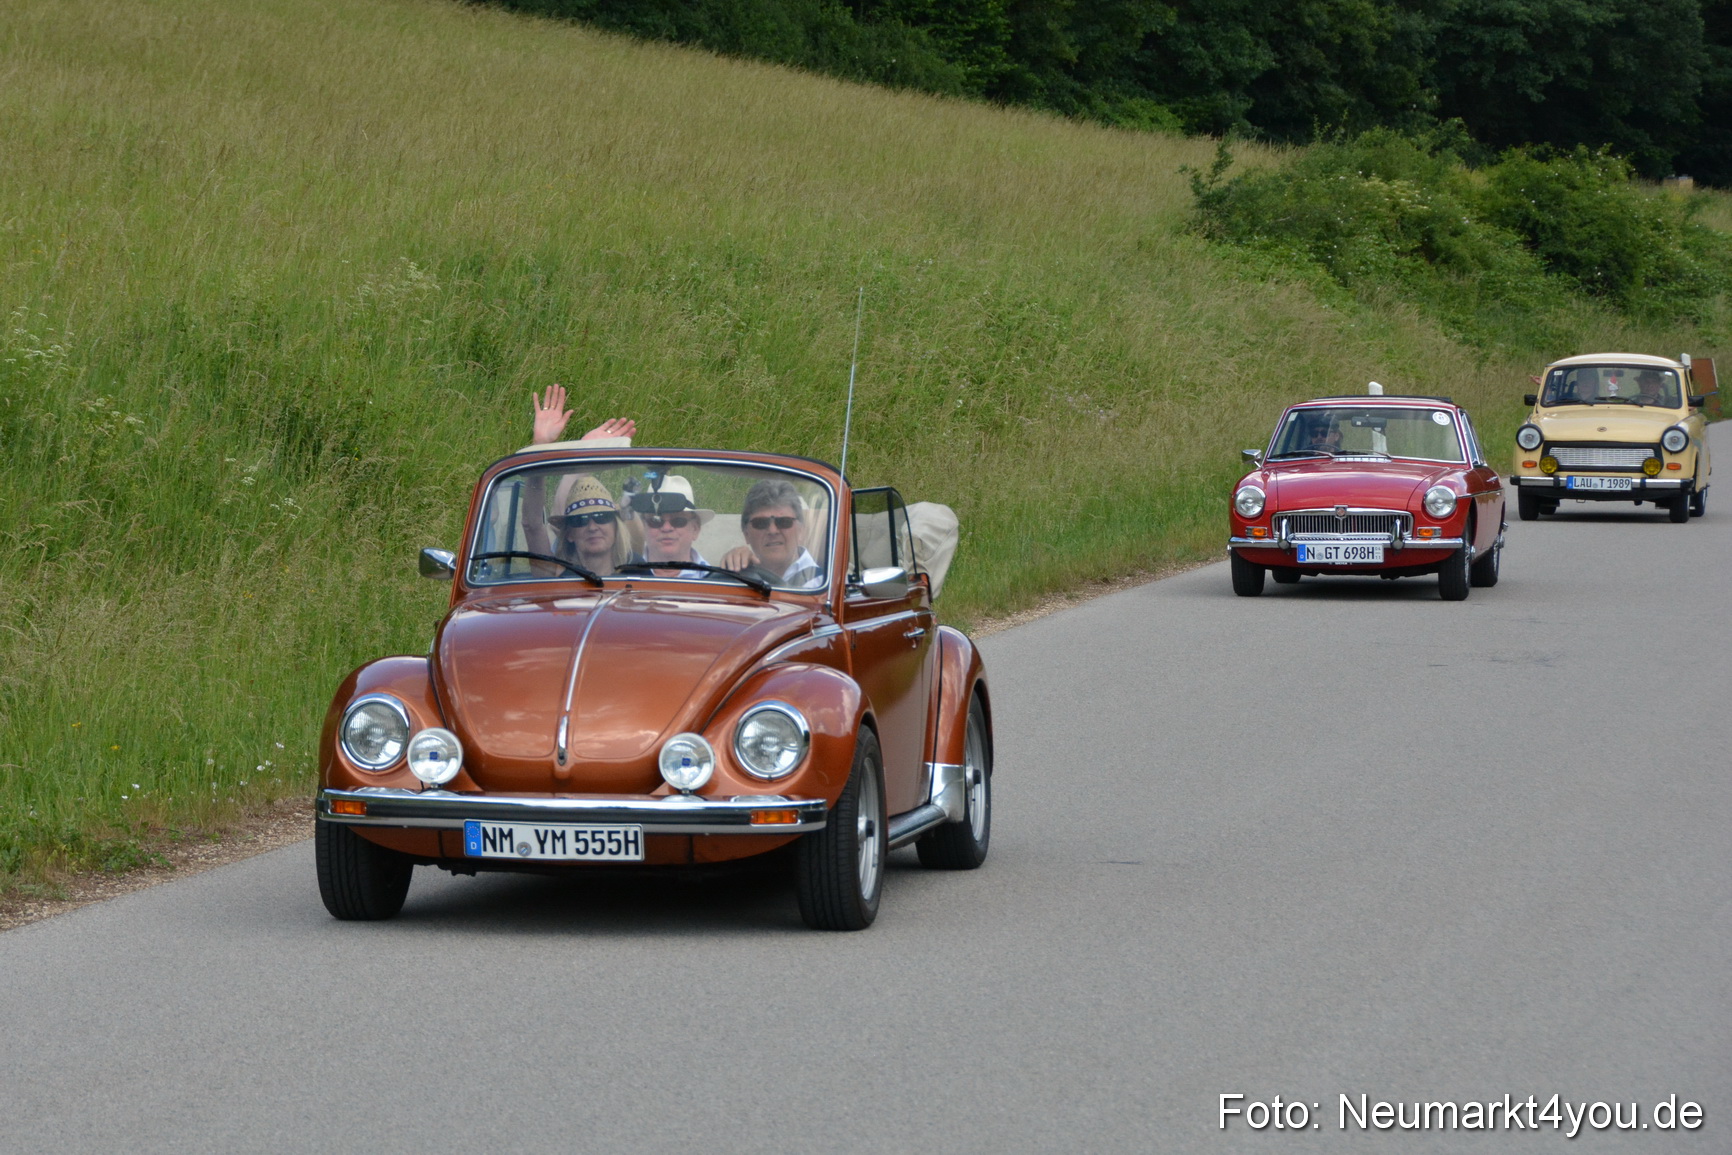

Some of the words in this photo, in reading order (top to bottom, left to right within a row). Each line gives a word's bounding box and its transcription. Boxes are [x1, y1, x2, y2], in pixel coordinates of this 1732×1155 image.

[1574, 477, 1592, 488] LAU
[1599, 478, 1605, 488] T
[1607, 478, 1630, 489] 1989
[1306, 546, 1315, 560] N
[1324, 546, 1340, 560] GT
[1343, 546, 1375, 560] 698H
[482, 826, 514, 853] NM
[534, 828, 567, 855] YM
[574, 830, 640, 856] 555H
